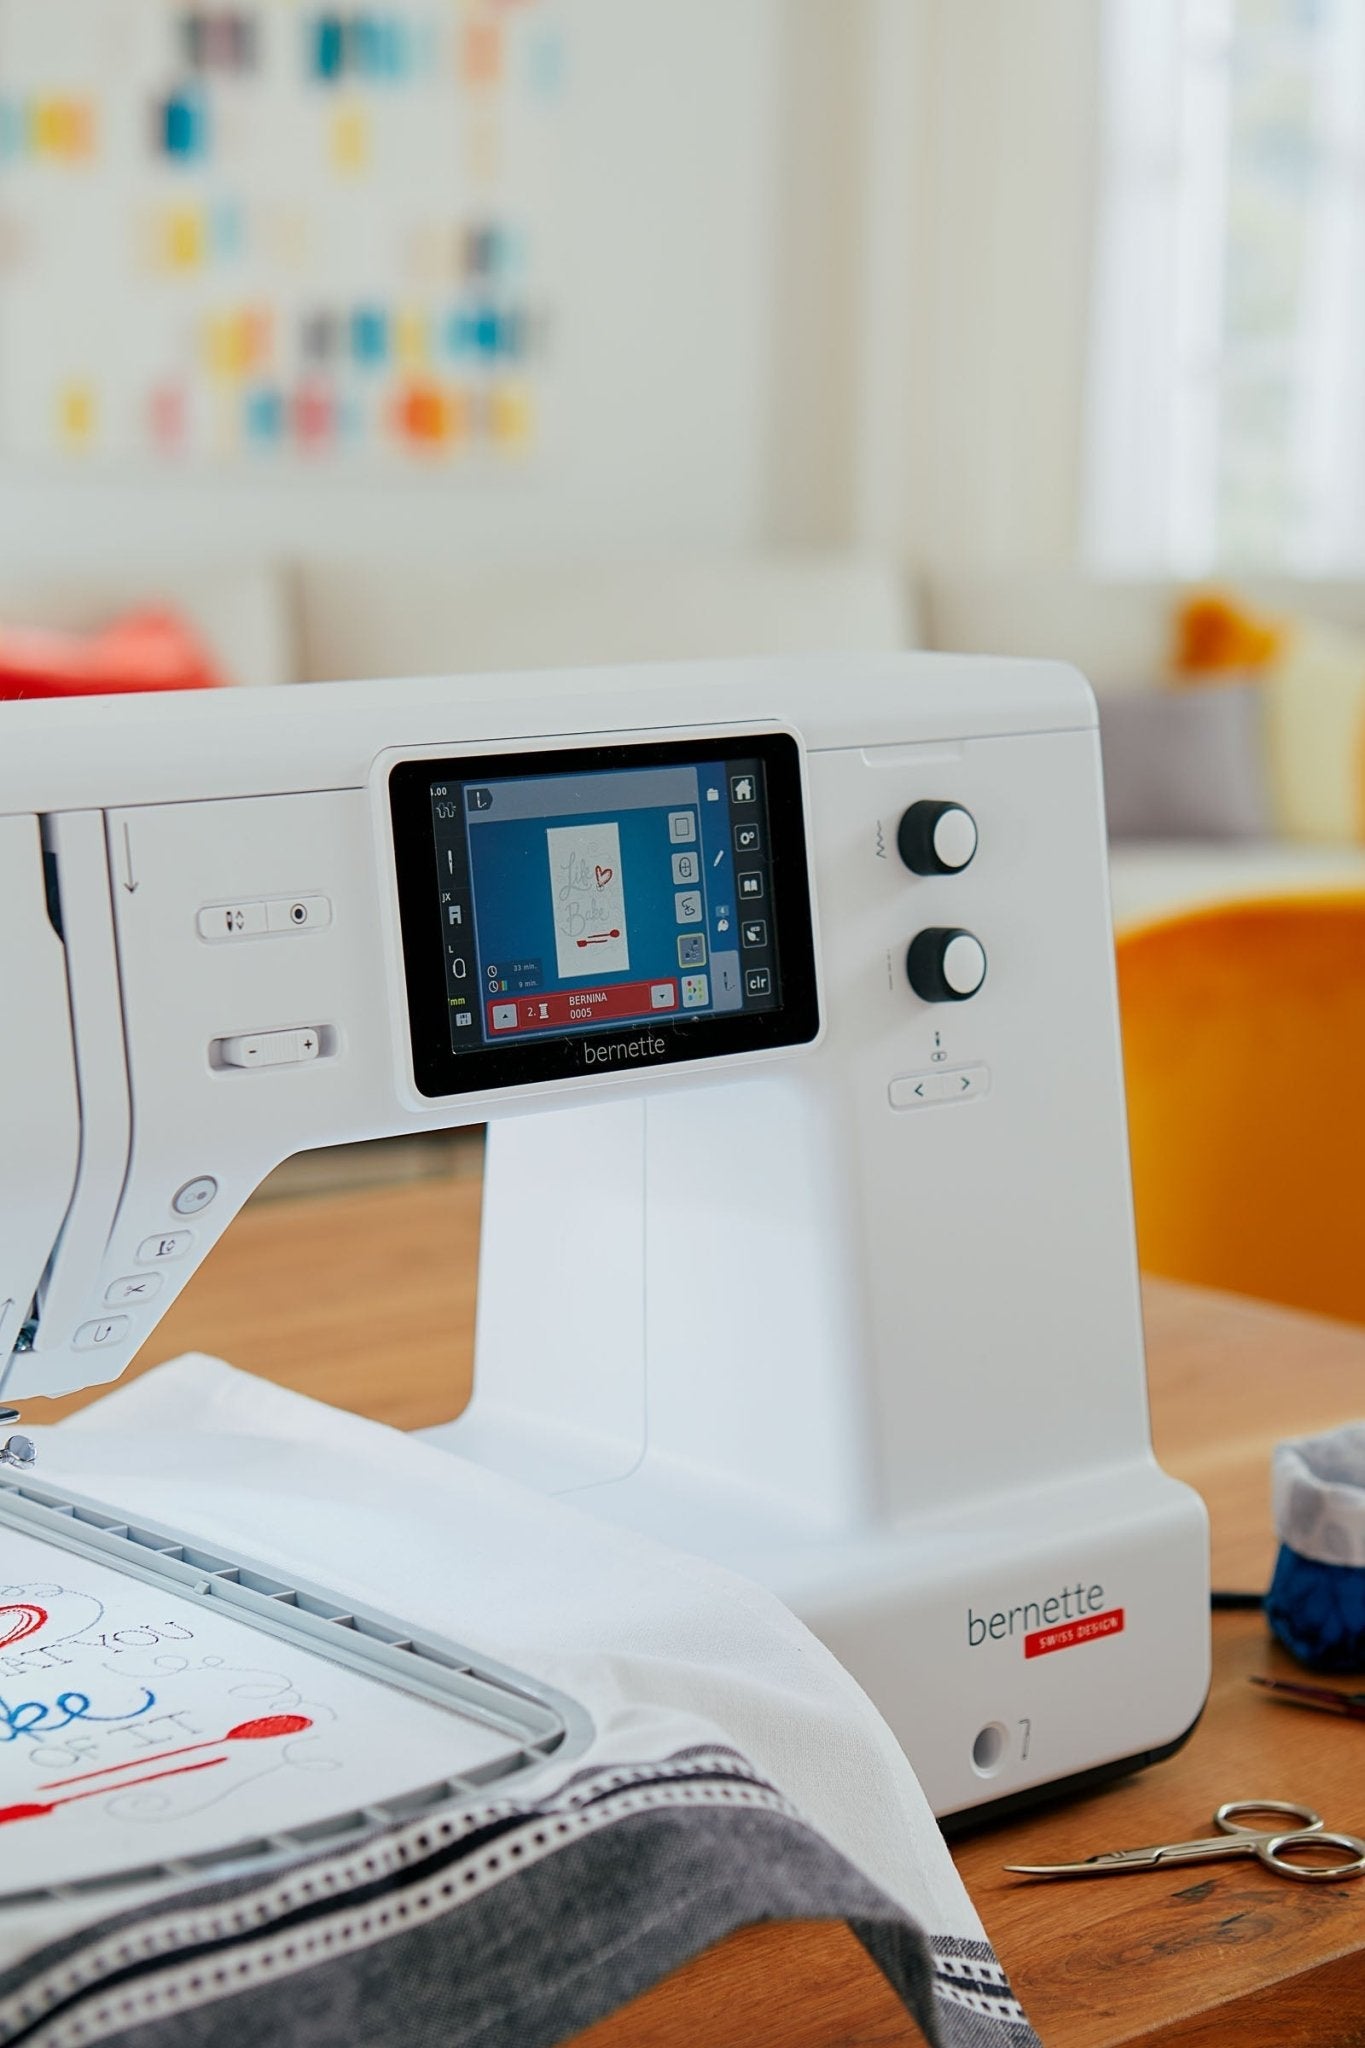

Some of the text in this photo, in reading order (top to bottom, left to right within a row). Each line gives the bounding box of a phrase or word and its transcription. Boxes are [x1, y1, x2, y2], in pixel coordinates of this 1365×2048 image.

[750, 976, 767, 989] clr
[448, 997, 466, 1006] mm
[569, 992, 608, 1006] BERNINA
[527, 1007, 537, 1017] 2.
[570, 1007, 592, 1020] 0005
[583, 1036, 666, 1064] bernette
[968, 1583, 1105, 1646] bernette
[69, 1620, 195, 1654] YOU
[1039, 1616, 1119, 1650] SWISS DESIGN
